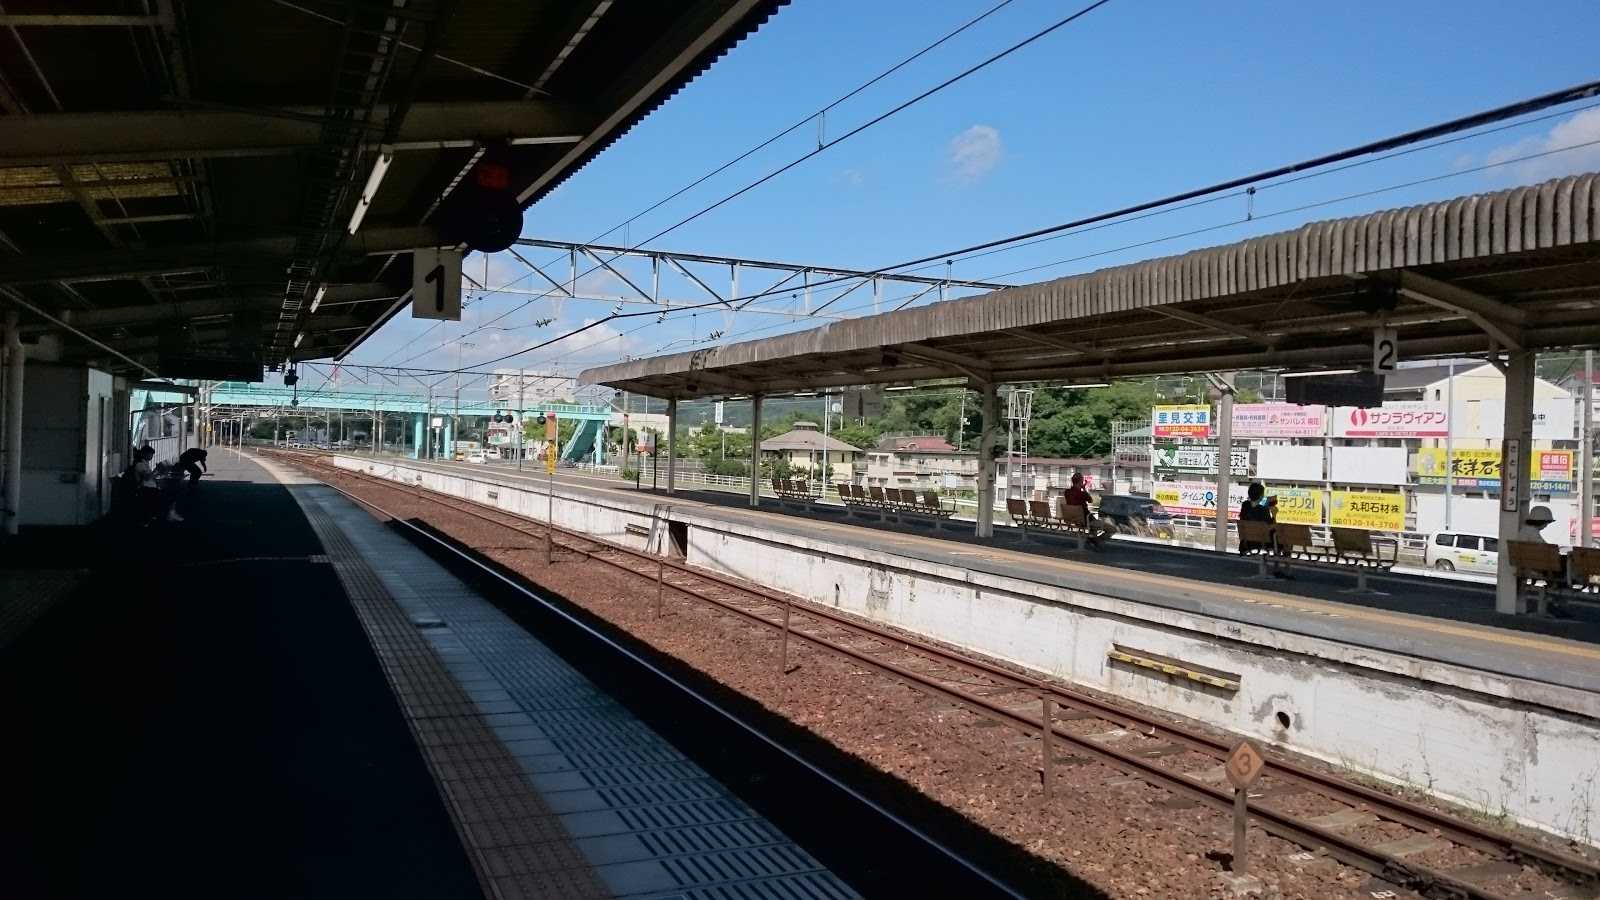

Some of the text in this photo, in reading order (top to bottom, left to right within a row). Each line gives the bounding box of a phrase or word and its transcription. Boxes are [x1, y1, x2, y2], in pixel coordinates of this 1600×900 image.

[425, 264, 445, 312] 1
[1378, 339, 1394, 371] 2
[1158, 412, 1208, 424] 里見交通
[1370, 411, 1446, 424] サンラヴィアン
[1238, 753, 1251, 776] 3
